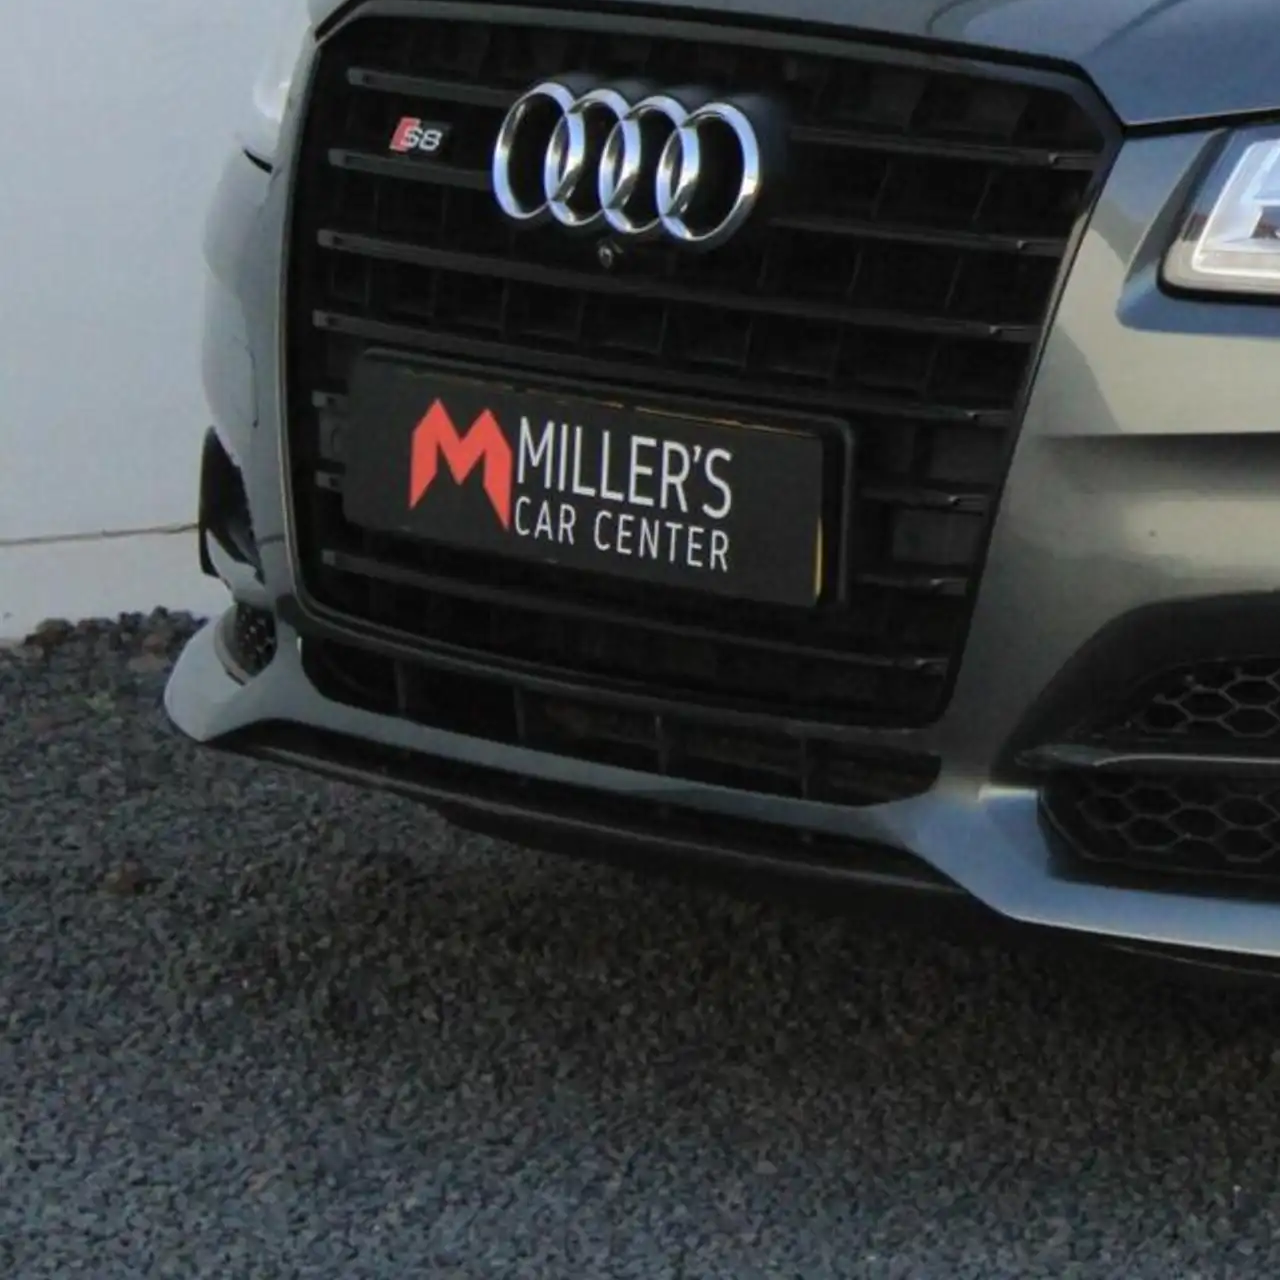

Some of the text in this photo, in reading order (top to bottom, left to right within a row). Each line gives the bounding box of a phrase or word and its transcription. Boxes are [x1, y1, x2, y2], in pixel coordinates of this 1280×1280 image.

[398, 124, 443, 152] S8
[517, 416, 733, 519] MILLER'S
[515, 496, 730, 572] CAR CENTER
